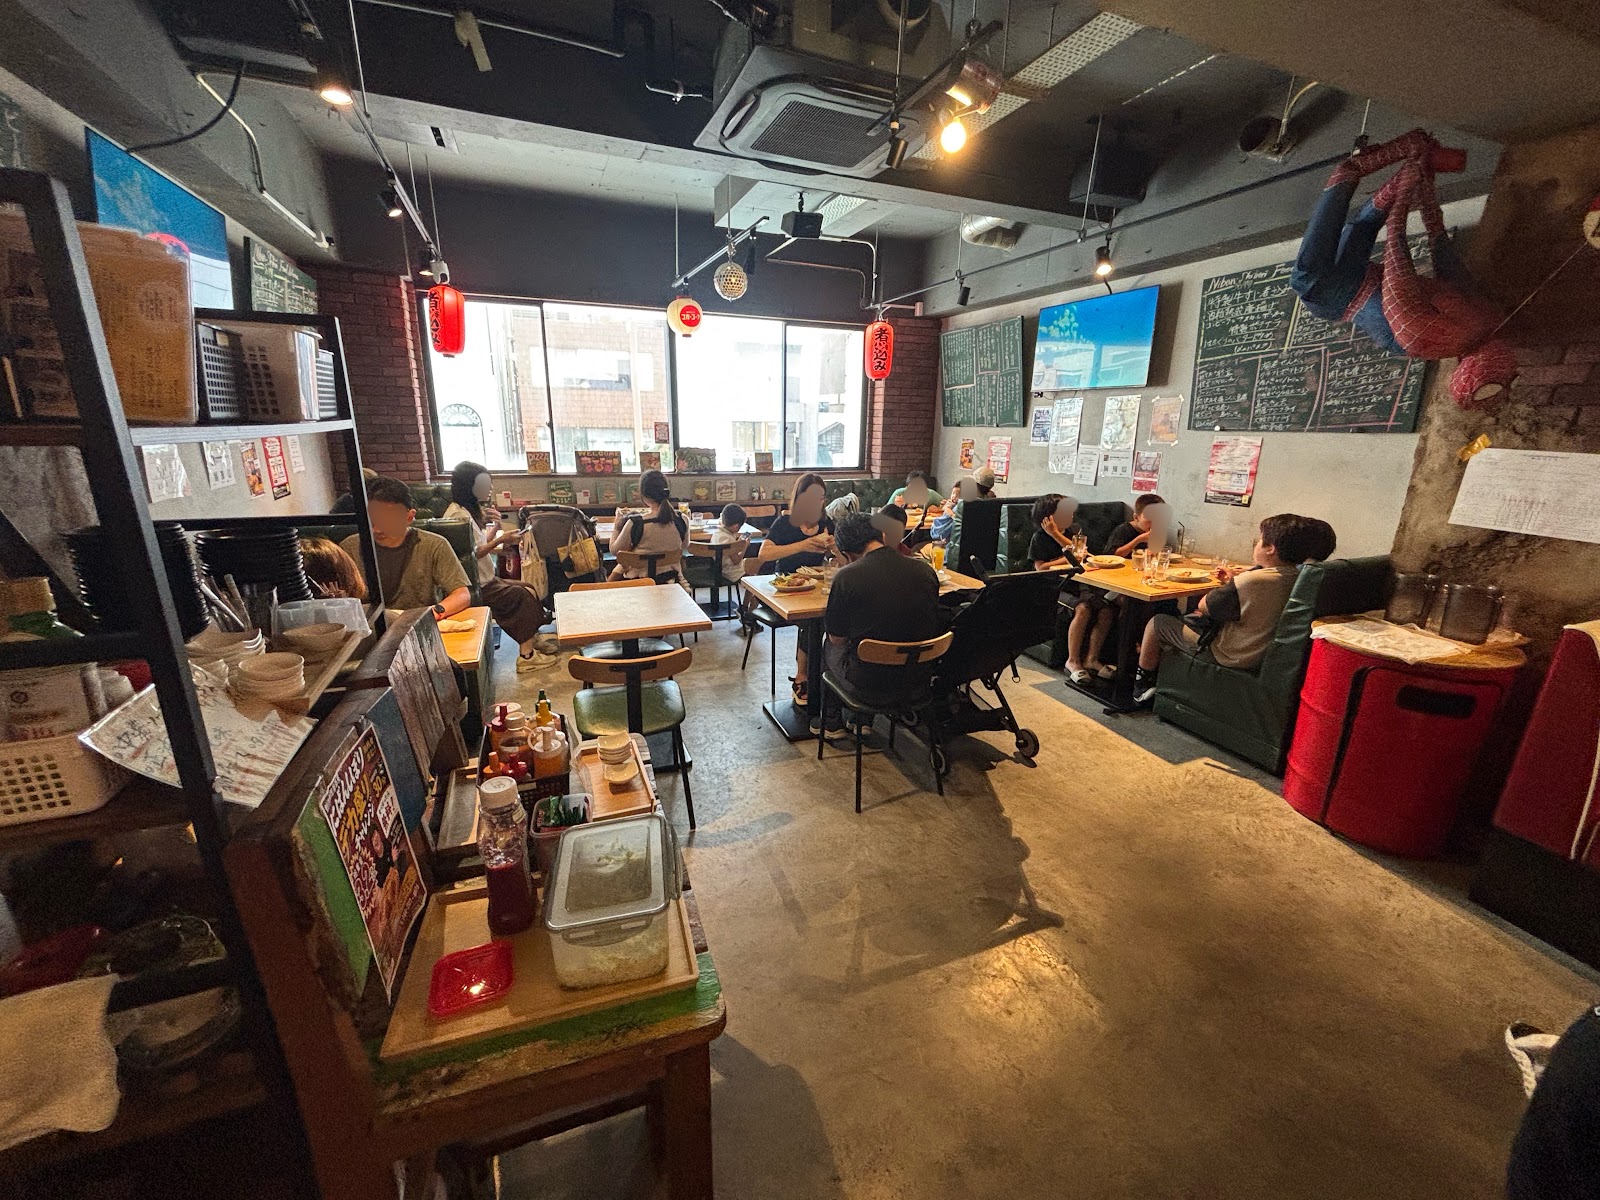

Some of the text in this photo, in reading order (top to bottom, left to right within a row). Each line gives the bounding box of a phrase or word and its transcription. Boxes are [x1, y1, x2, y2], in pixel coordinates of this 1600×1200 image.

[874, 327, 889, 370] 煮込み
[528, 453, 549, 465] PIZZA
[329, 746, 365, 839] にばんしぼり
[339, 773, 370, 862] デカ盛り
[354, 795, 375, 851] チャレンジ
